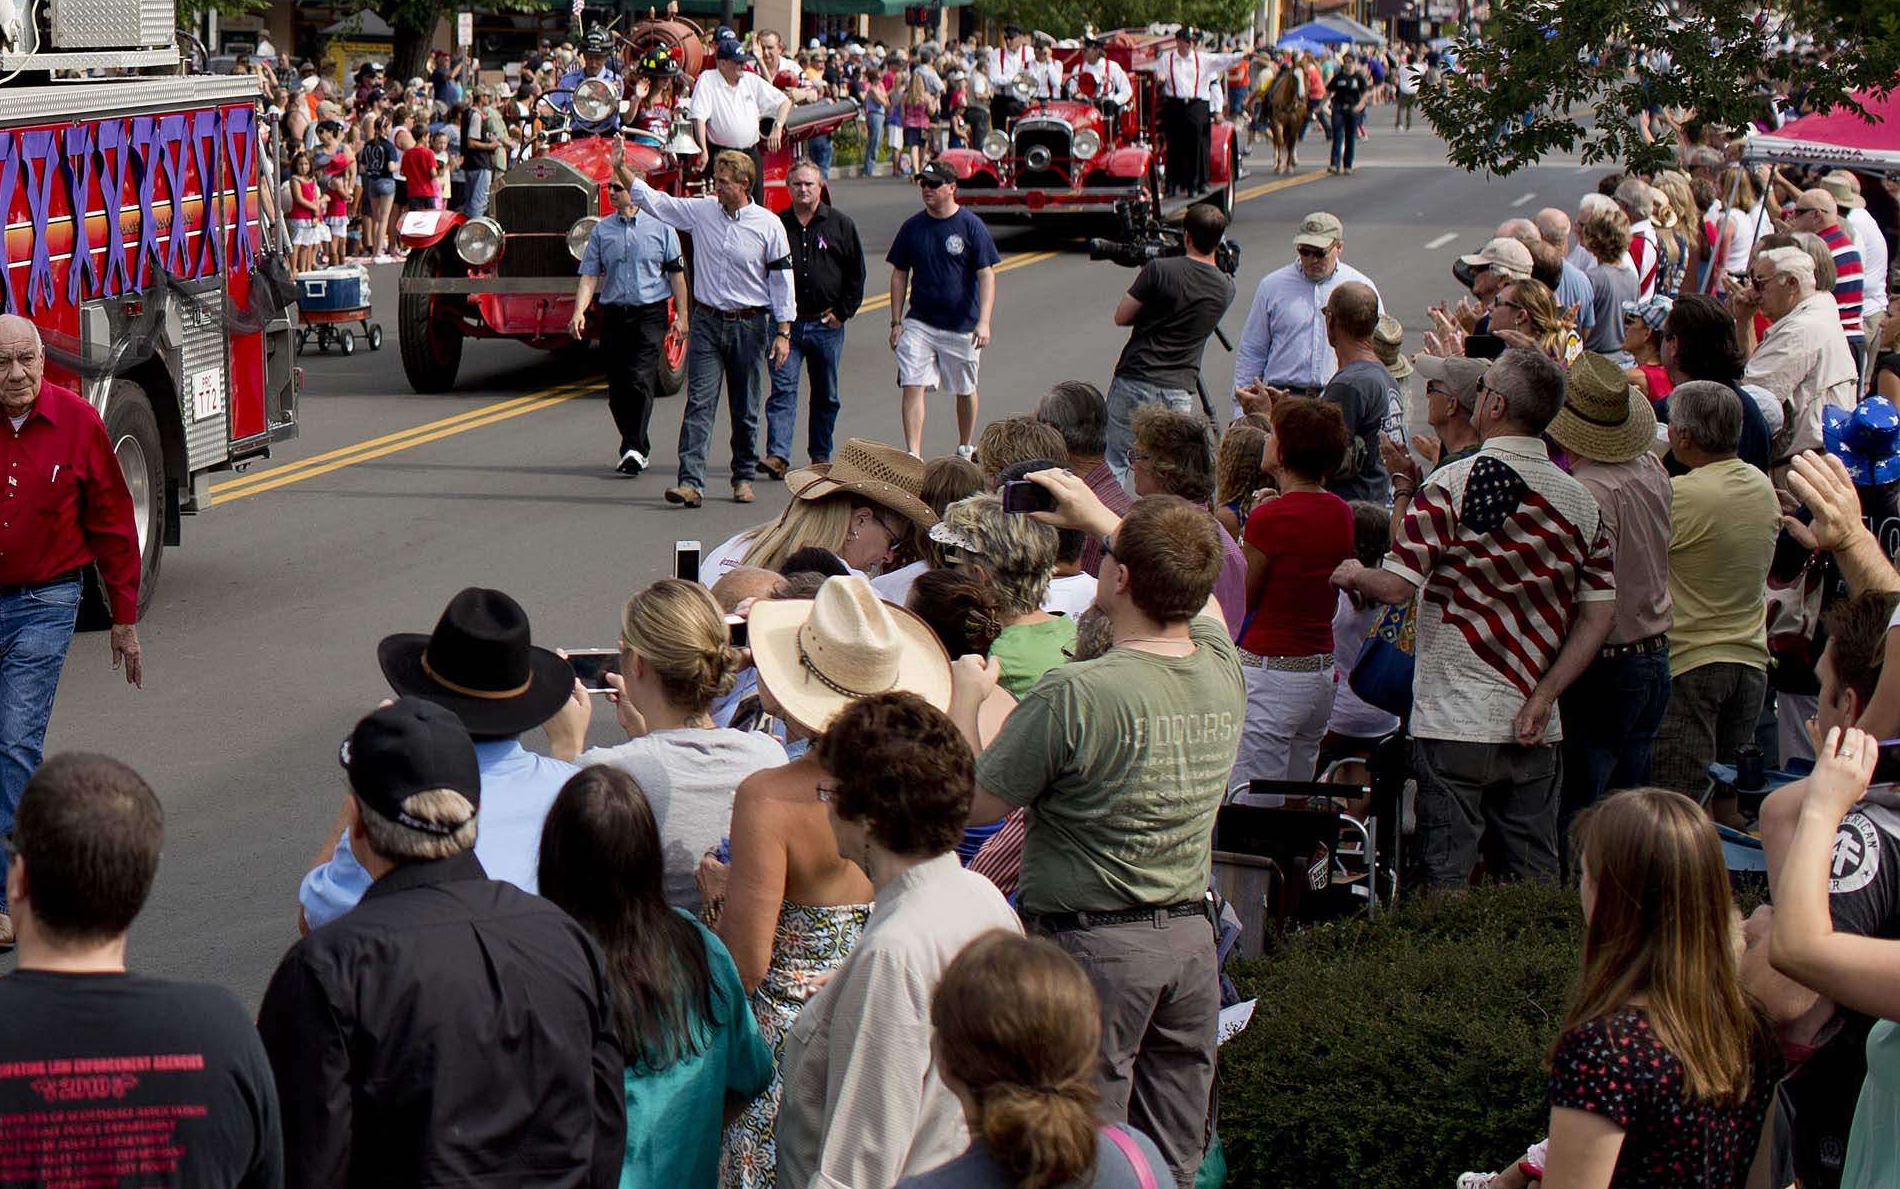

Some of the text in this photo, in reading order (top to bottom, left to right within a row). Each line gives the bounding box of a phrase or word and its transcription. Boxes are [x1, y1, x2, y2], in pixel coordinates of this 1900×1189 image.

[198, 387, 218, 413] T72
[48, 1059, 72, 1075] LAW
[73, 1056, 151, 1073] ENFORCEMENT
[152, 1053, 205, 1070] AGENCIES
